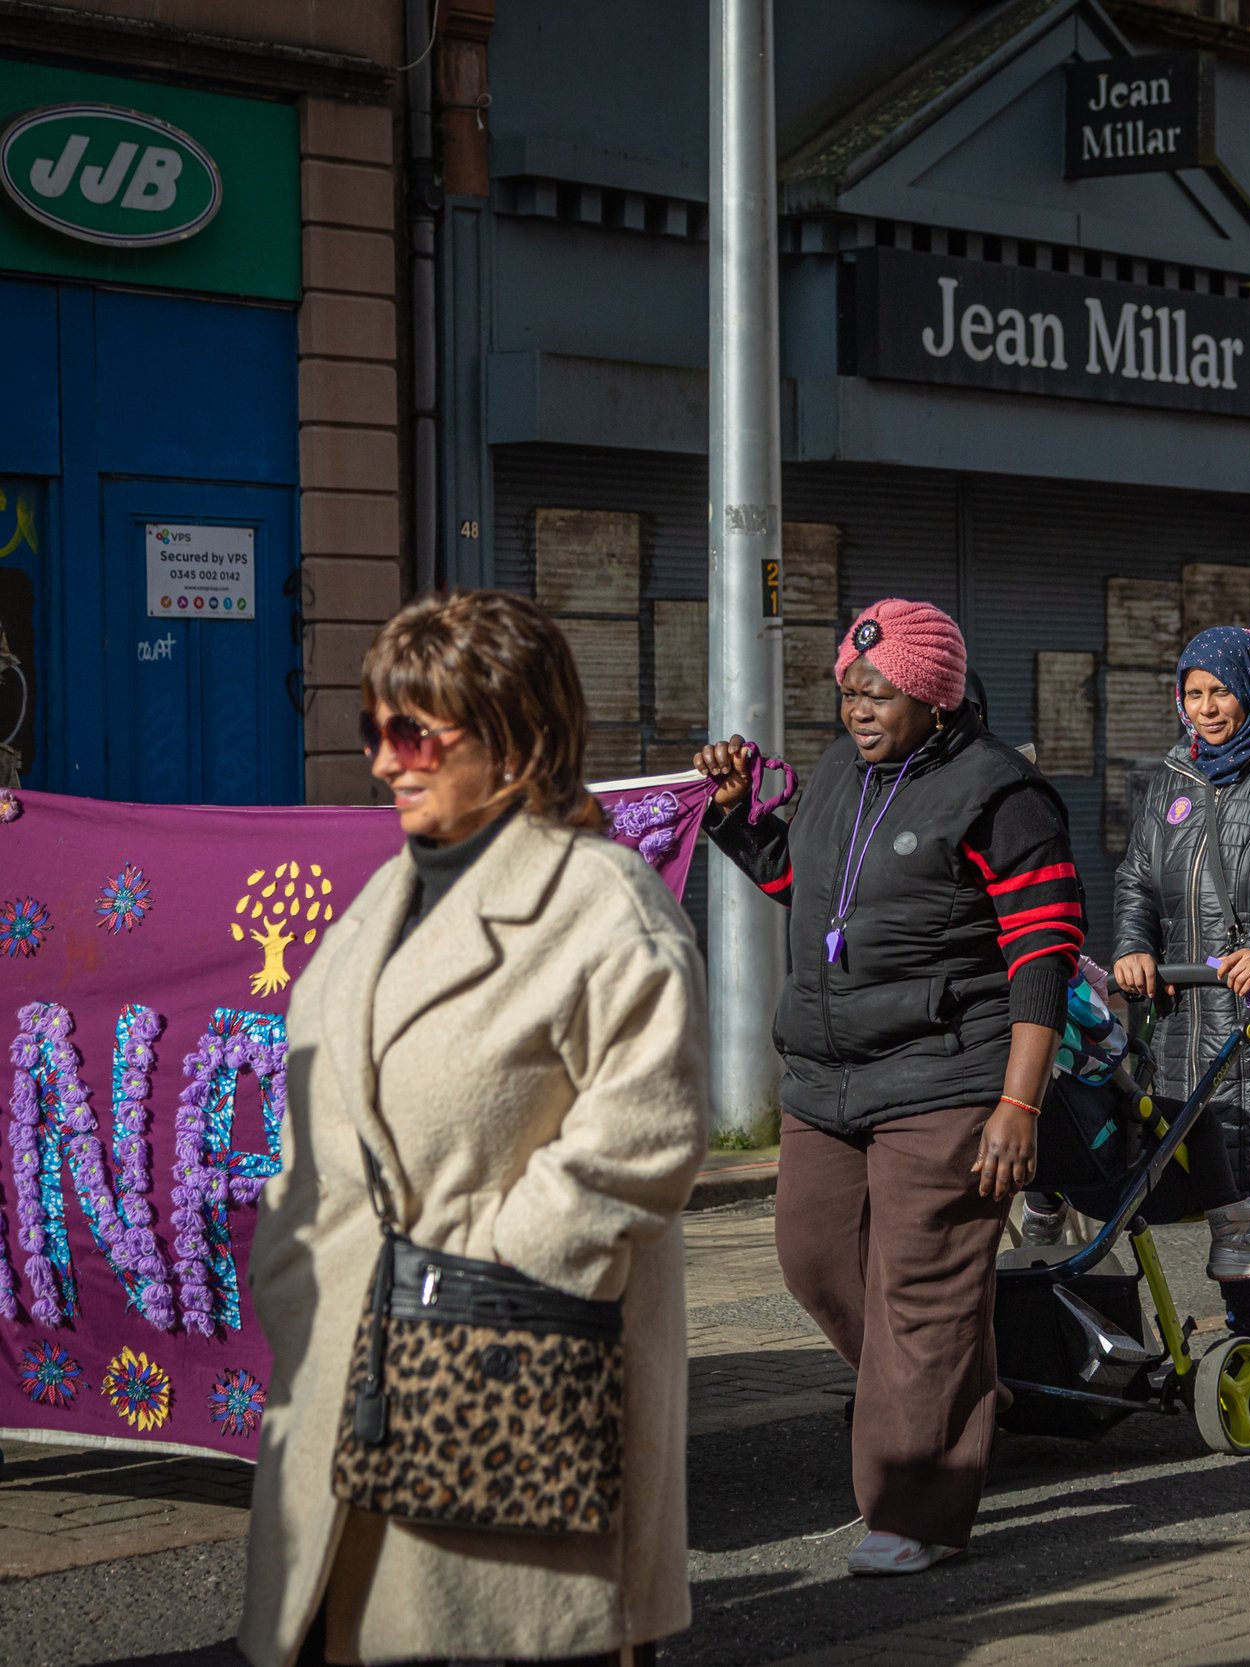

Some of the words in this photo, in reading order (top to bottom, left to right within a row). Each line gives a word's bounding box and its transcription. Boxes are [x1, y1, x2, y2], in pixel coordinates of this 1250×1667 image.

[1089, 74, 1171, 111] Jean
[1082, 120, 1181, 160] Millar
[30, 134, 183, 211] JJB
[922, 277, 1068, 370] Jean
[1085, 298, 1244, 390] Millar
[171, 533, 192, 542] VPS
[461, 521, 479, 538] 48
[160, 551, 208, 563] Secured
[212, 552, 224, 565] by
[227, 553, 248, 564] VPS
[170, 570, 196, 580] 0345
[199, 570, 217, 580] 002
[220, 571, 240, 581] 0142
